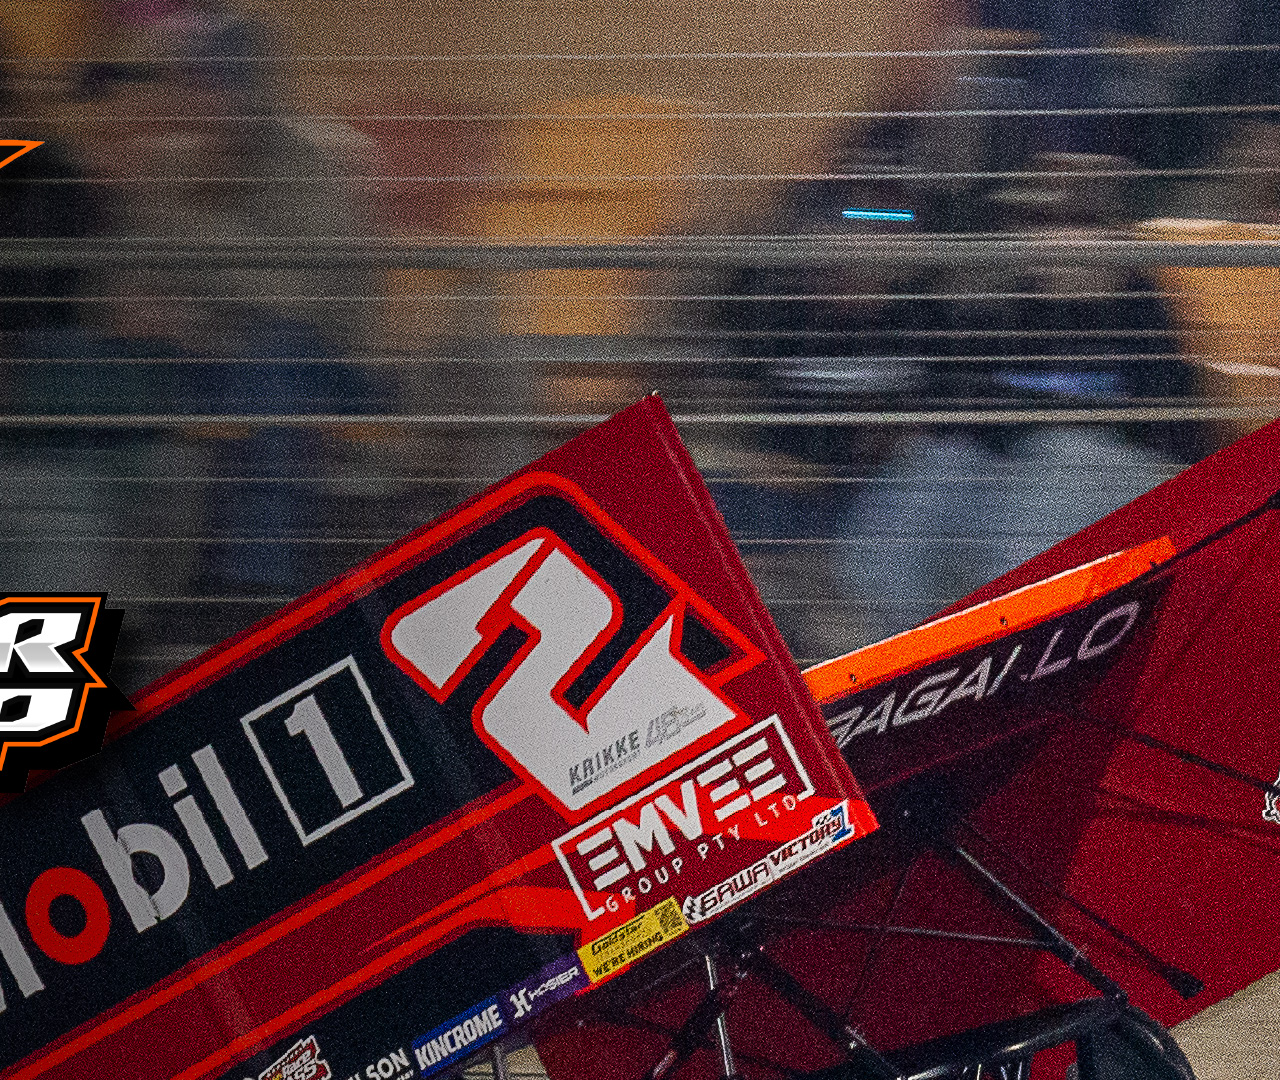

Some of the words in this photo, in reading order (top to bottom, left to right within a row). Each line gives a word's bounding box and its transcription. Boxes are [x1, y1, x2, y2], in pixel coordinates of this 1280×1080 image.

[380, 525, 752, 812] 2
[569, 729, 640, 787] KRIKKE
[576, 737, 787, 892] EMVEE
[769, 816, 843, 868] VICTORY
[605, 856, 684, 913] GROUP
[696, 824, 741, 862] PTY
[753, 794, 797, 828] LTD
[625, 932, 664, 962] HIRING
[414, 1004, 503, 1071] KINCROME
